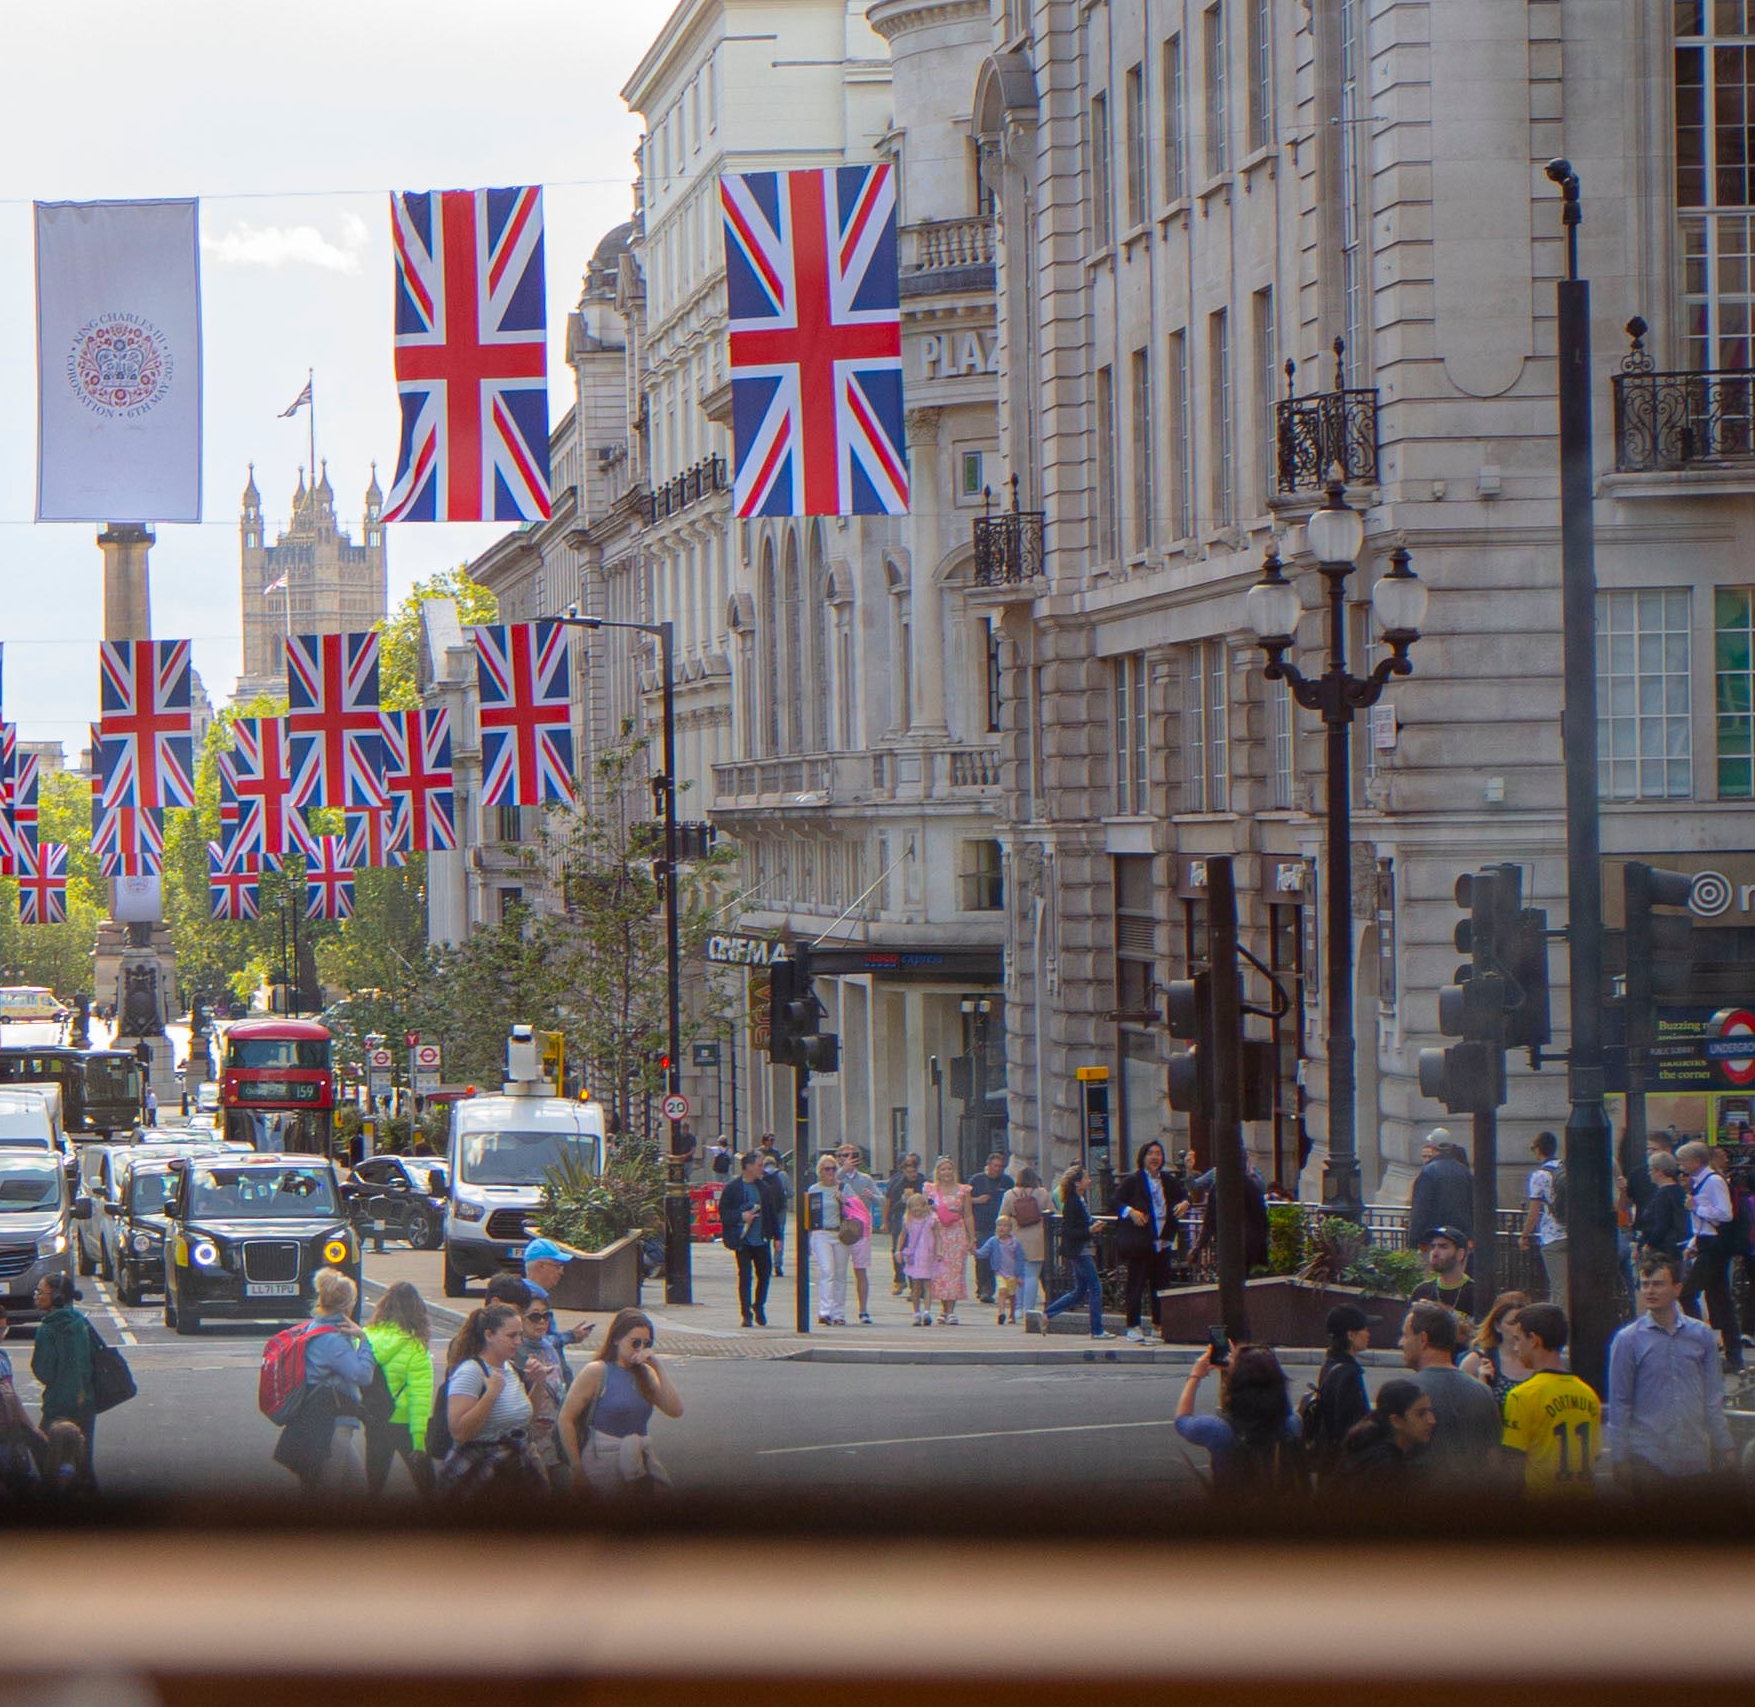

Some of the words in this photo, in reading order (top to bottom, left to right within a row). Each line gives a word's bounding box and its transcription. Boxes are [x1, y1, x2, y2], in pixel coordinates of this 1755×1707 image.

[72, 318, 98, 344] KING
[99, 313, 153, 332] CHARLES
[153, 329, 166, 344] III
[67, 354, 115, 418] CORONATION
[150, 382, 170, 404] MAY
[1659, 1020, 1701, 1032] Buzzing
[297, 1085, 314, 1098] 159
[667, 1101, 686, 1113] 20
[1553, 1421, 1590, 1482] 11
